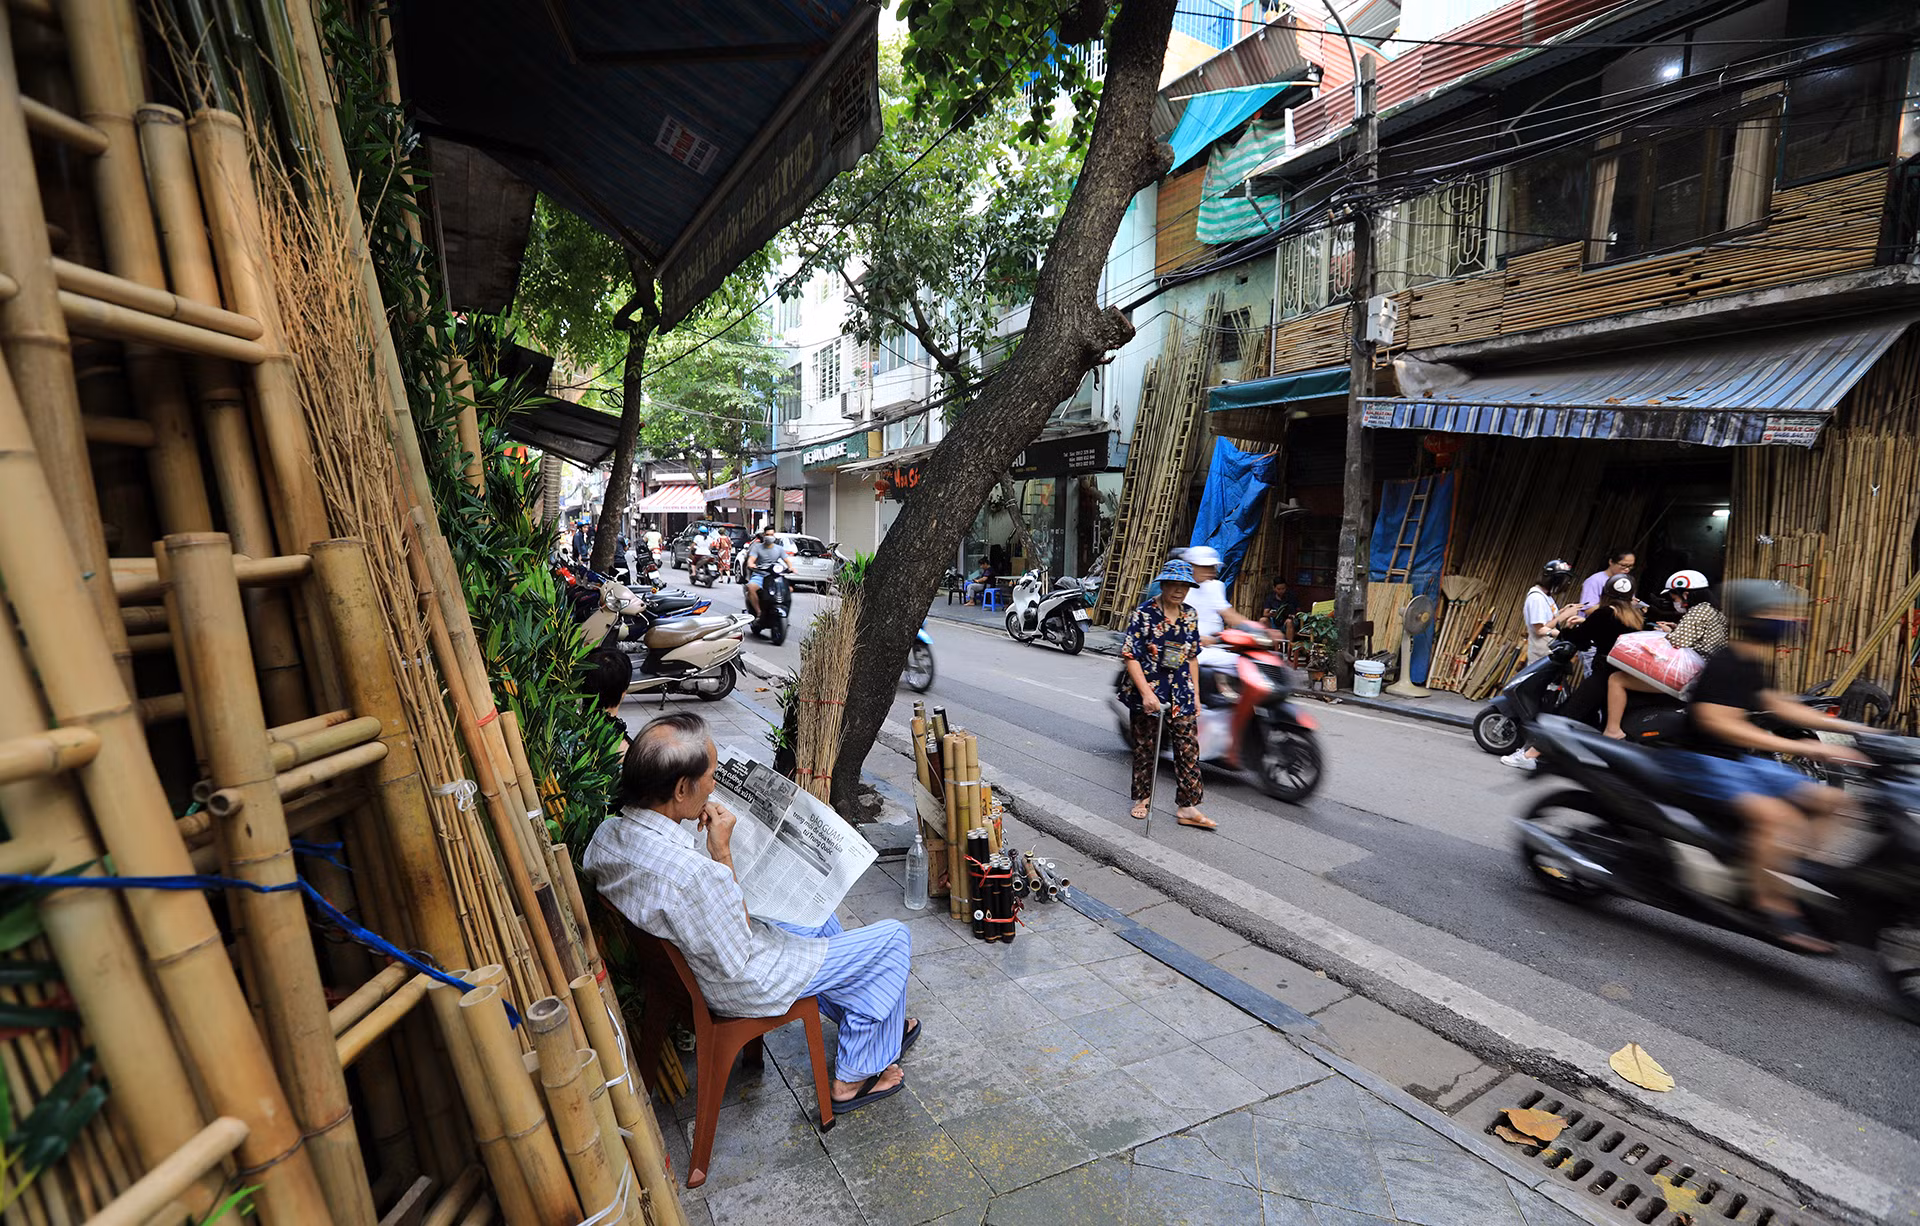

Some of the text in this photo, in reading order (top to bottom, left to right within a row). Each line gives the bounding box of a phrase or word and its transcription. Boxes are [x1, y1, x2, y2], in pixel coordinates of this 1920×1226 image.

[792, 812, 805, 825] trong
[822, 824, 844, 843] GUAM
[808, 833, 822, 848] Trung
[820, 842, 833, 856] Quốc
